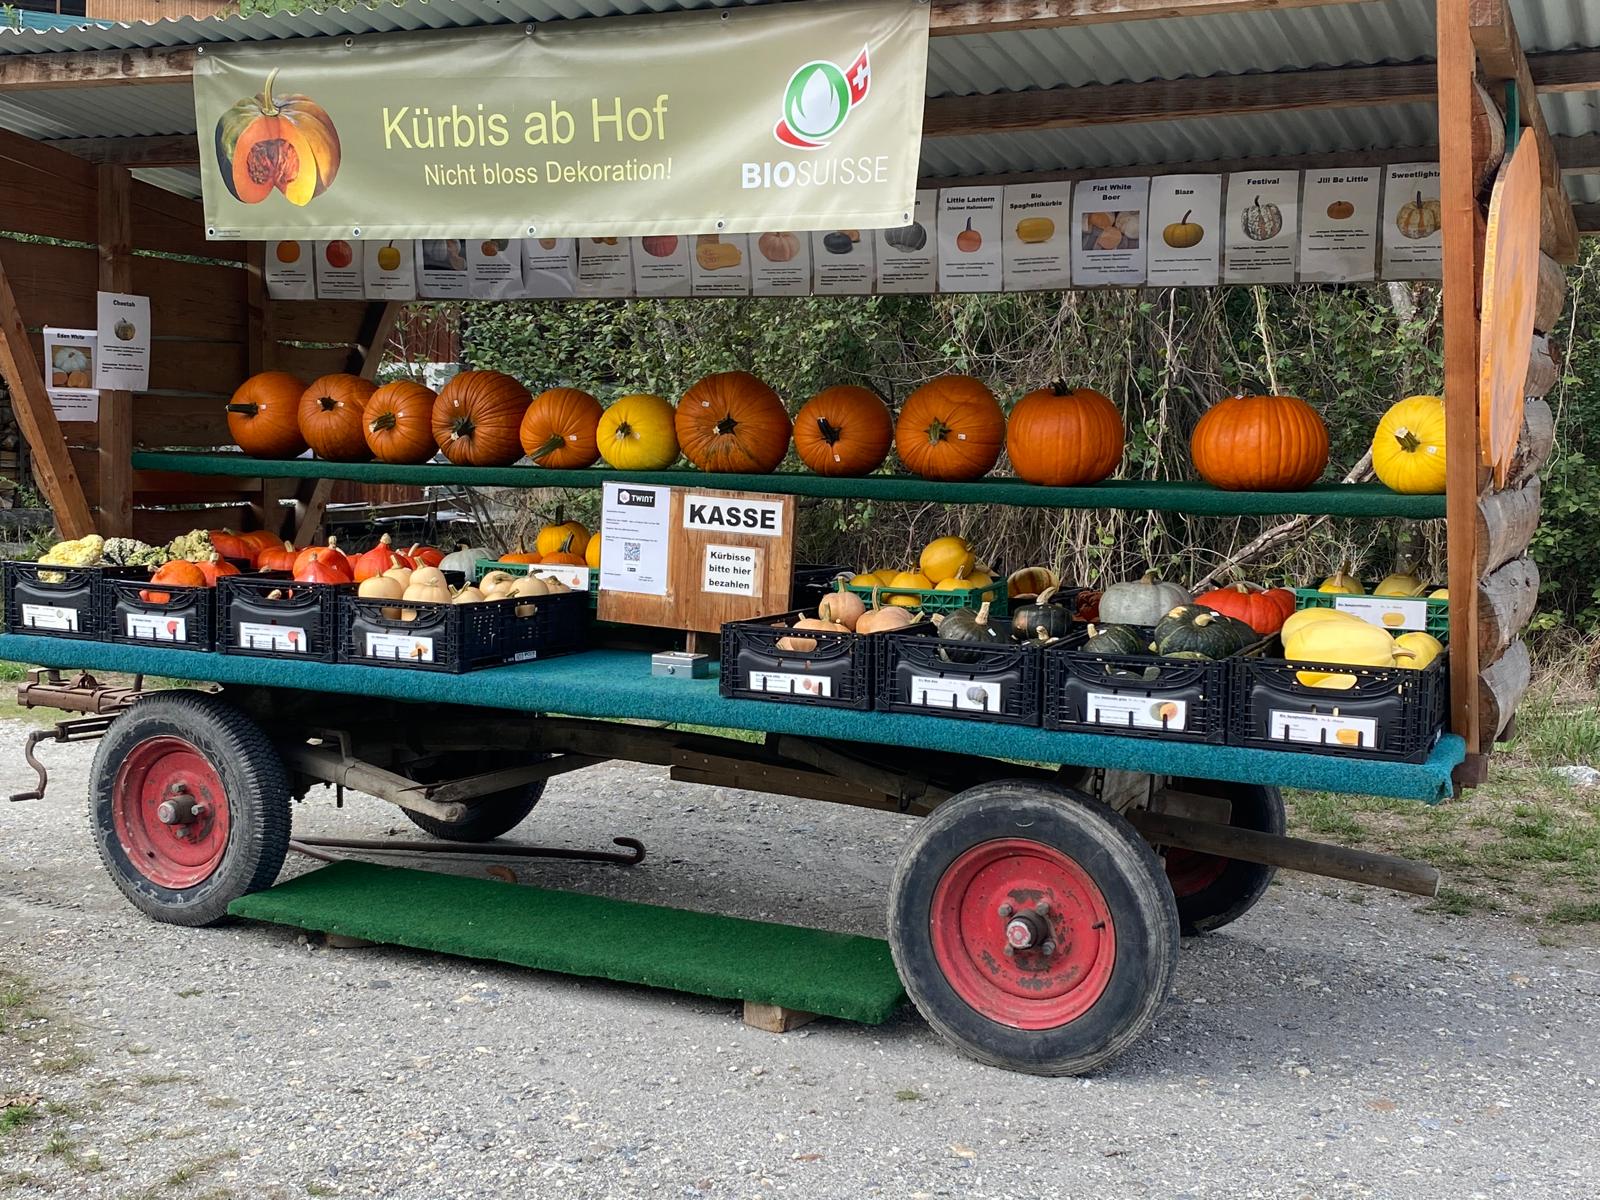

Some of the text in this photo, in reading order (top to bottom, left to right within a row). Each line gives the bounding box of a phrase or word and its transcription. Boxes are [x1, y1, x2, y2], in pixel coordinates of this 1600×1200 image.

[382, 94, 669, 149] Kürbis ab Hof
[424, 157, 673, 186] Nicht bloss Dekoration!
[1247, 177, 1280, 185] Festival
[1317, 175, 1369, 184] Jill Be Little
[1109, 183, 1132, 191] White
[1009, 199, 1063, 210] Spaghettikürbis
[631, 494, 654, 503] TWINT
[689, 503, 776, 530] KASSE
[710, 550, 751, 563] Kürbisse
[708, 564, 752, 576] bitte hier
[708, 578, 750, 590] bezahlen
